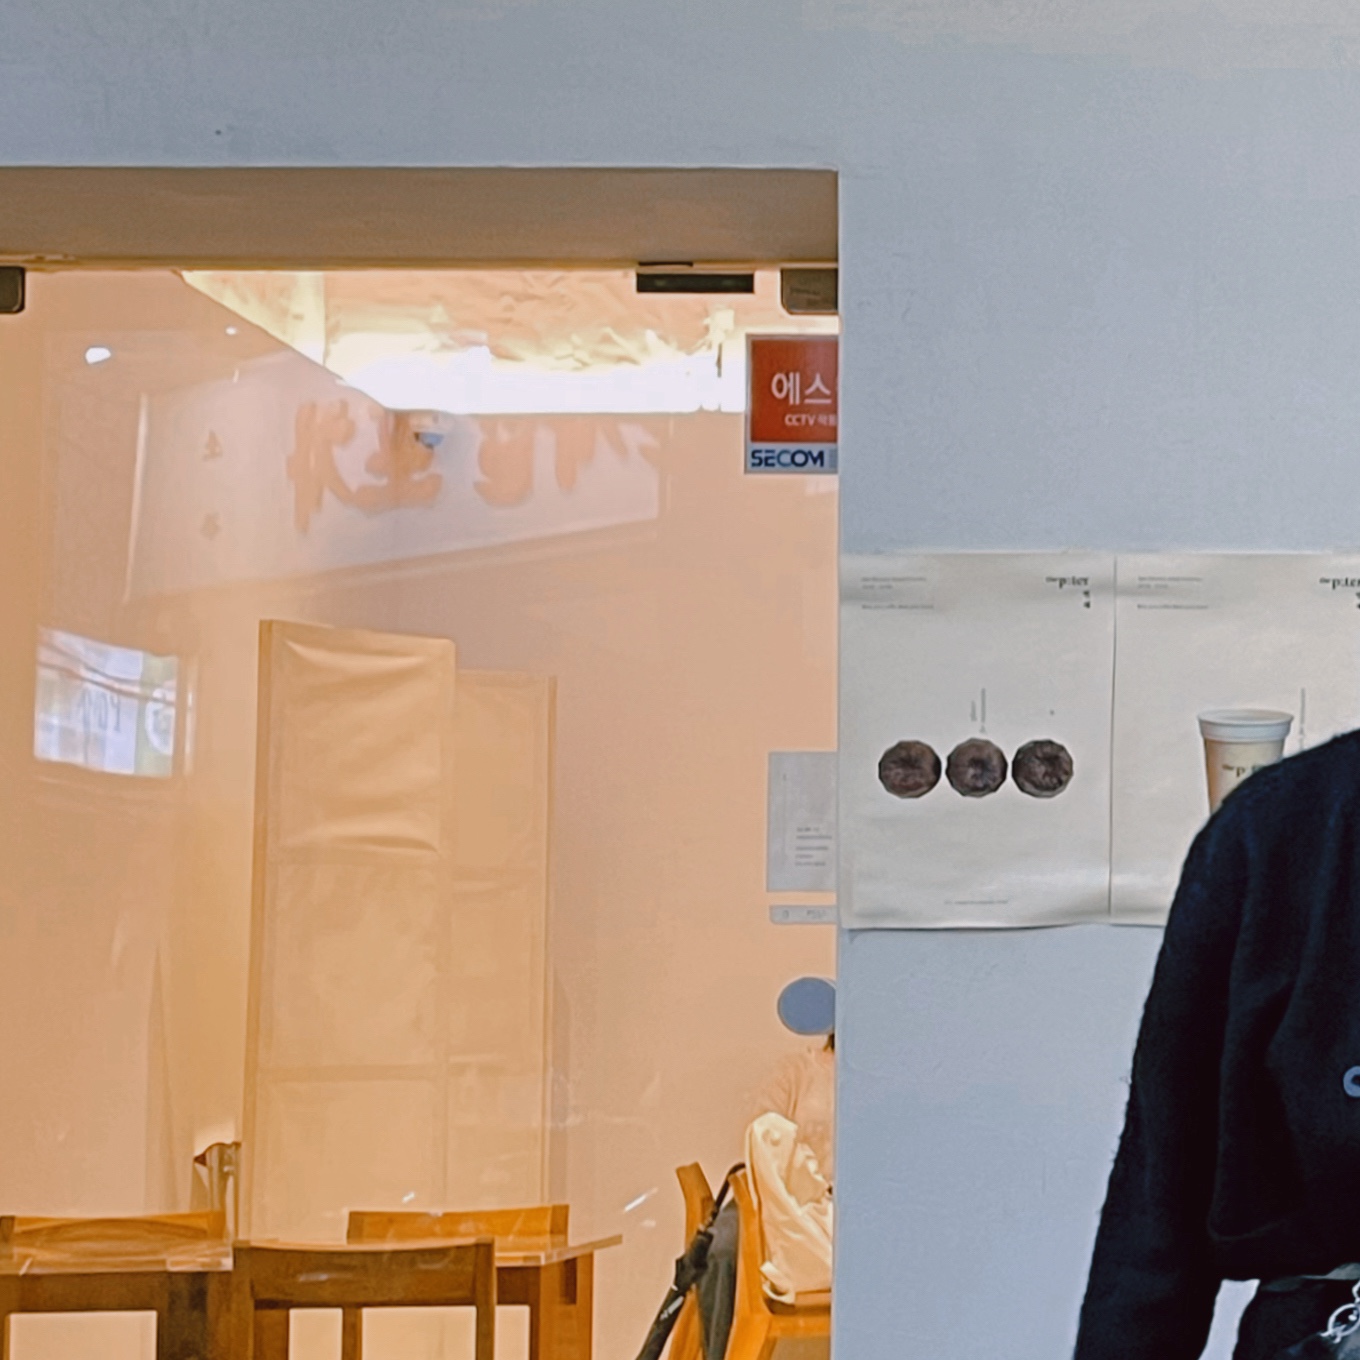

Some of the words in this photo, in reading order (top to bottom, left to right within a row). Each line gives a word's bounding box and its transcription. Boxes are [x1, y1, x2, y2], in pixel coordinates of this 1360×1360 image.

[771, 371, 837, 405] 에스
[784, 413, 816, 427] CCTV
[751, 449, 824, 468] SECOM
